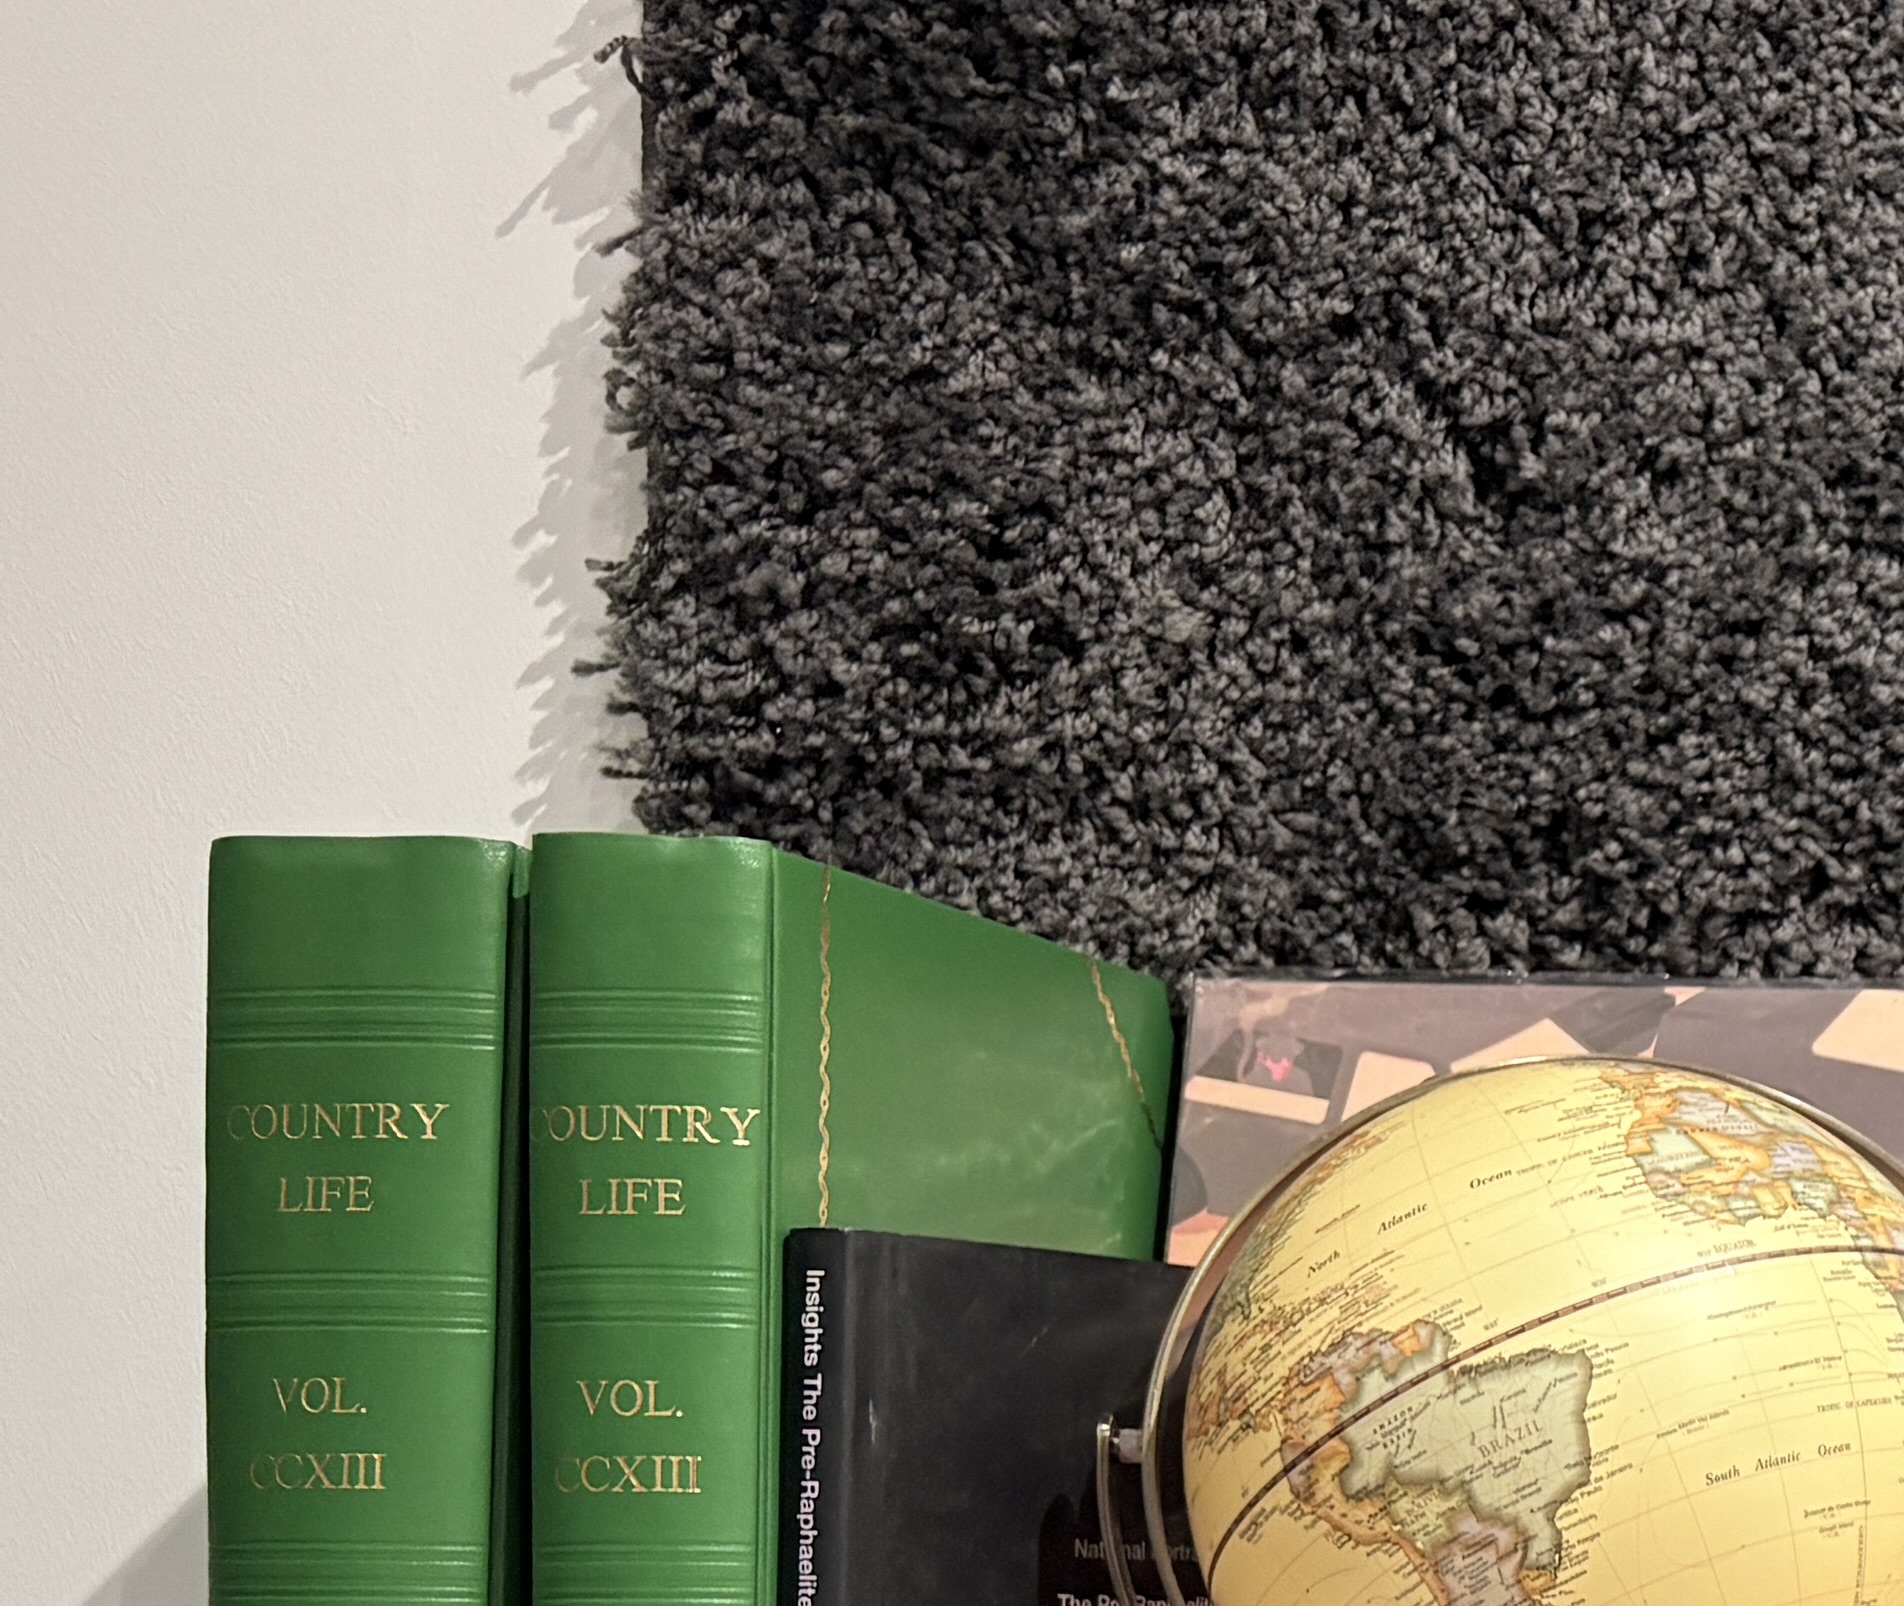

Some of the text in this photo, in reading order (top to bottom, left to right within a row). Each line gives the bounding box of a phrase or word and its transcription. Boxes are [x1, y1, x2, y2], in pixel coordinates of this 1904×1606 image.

[226, 1102, 450, 1140] COUNTRY
[277, 1175, 375, 1212] LIFE
[578, 1178, 686, 1216] LIFE
[1377, 1203, 1428, 1235] Atlantic
[1469, 1168, 1513, 1190] Ocean
[801, 1269, 826, 1367] Insights
[273, 1377, 368, 1415] VOL.
[576, 1379, 683, 1418] VOL.
[802, 1374, 823, 1421] The
[1478, 1419, 1544, 1459] BRAZIL
[249, 1452, 387, 1490] CCXIII
[554, 1456, 702, 1493] CCXIII
[1705, 1441, 1852, 1487] South Atlantic Ocean
